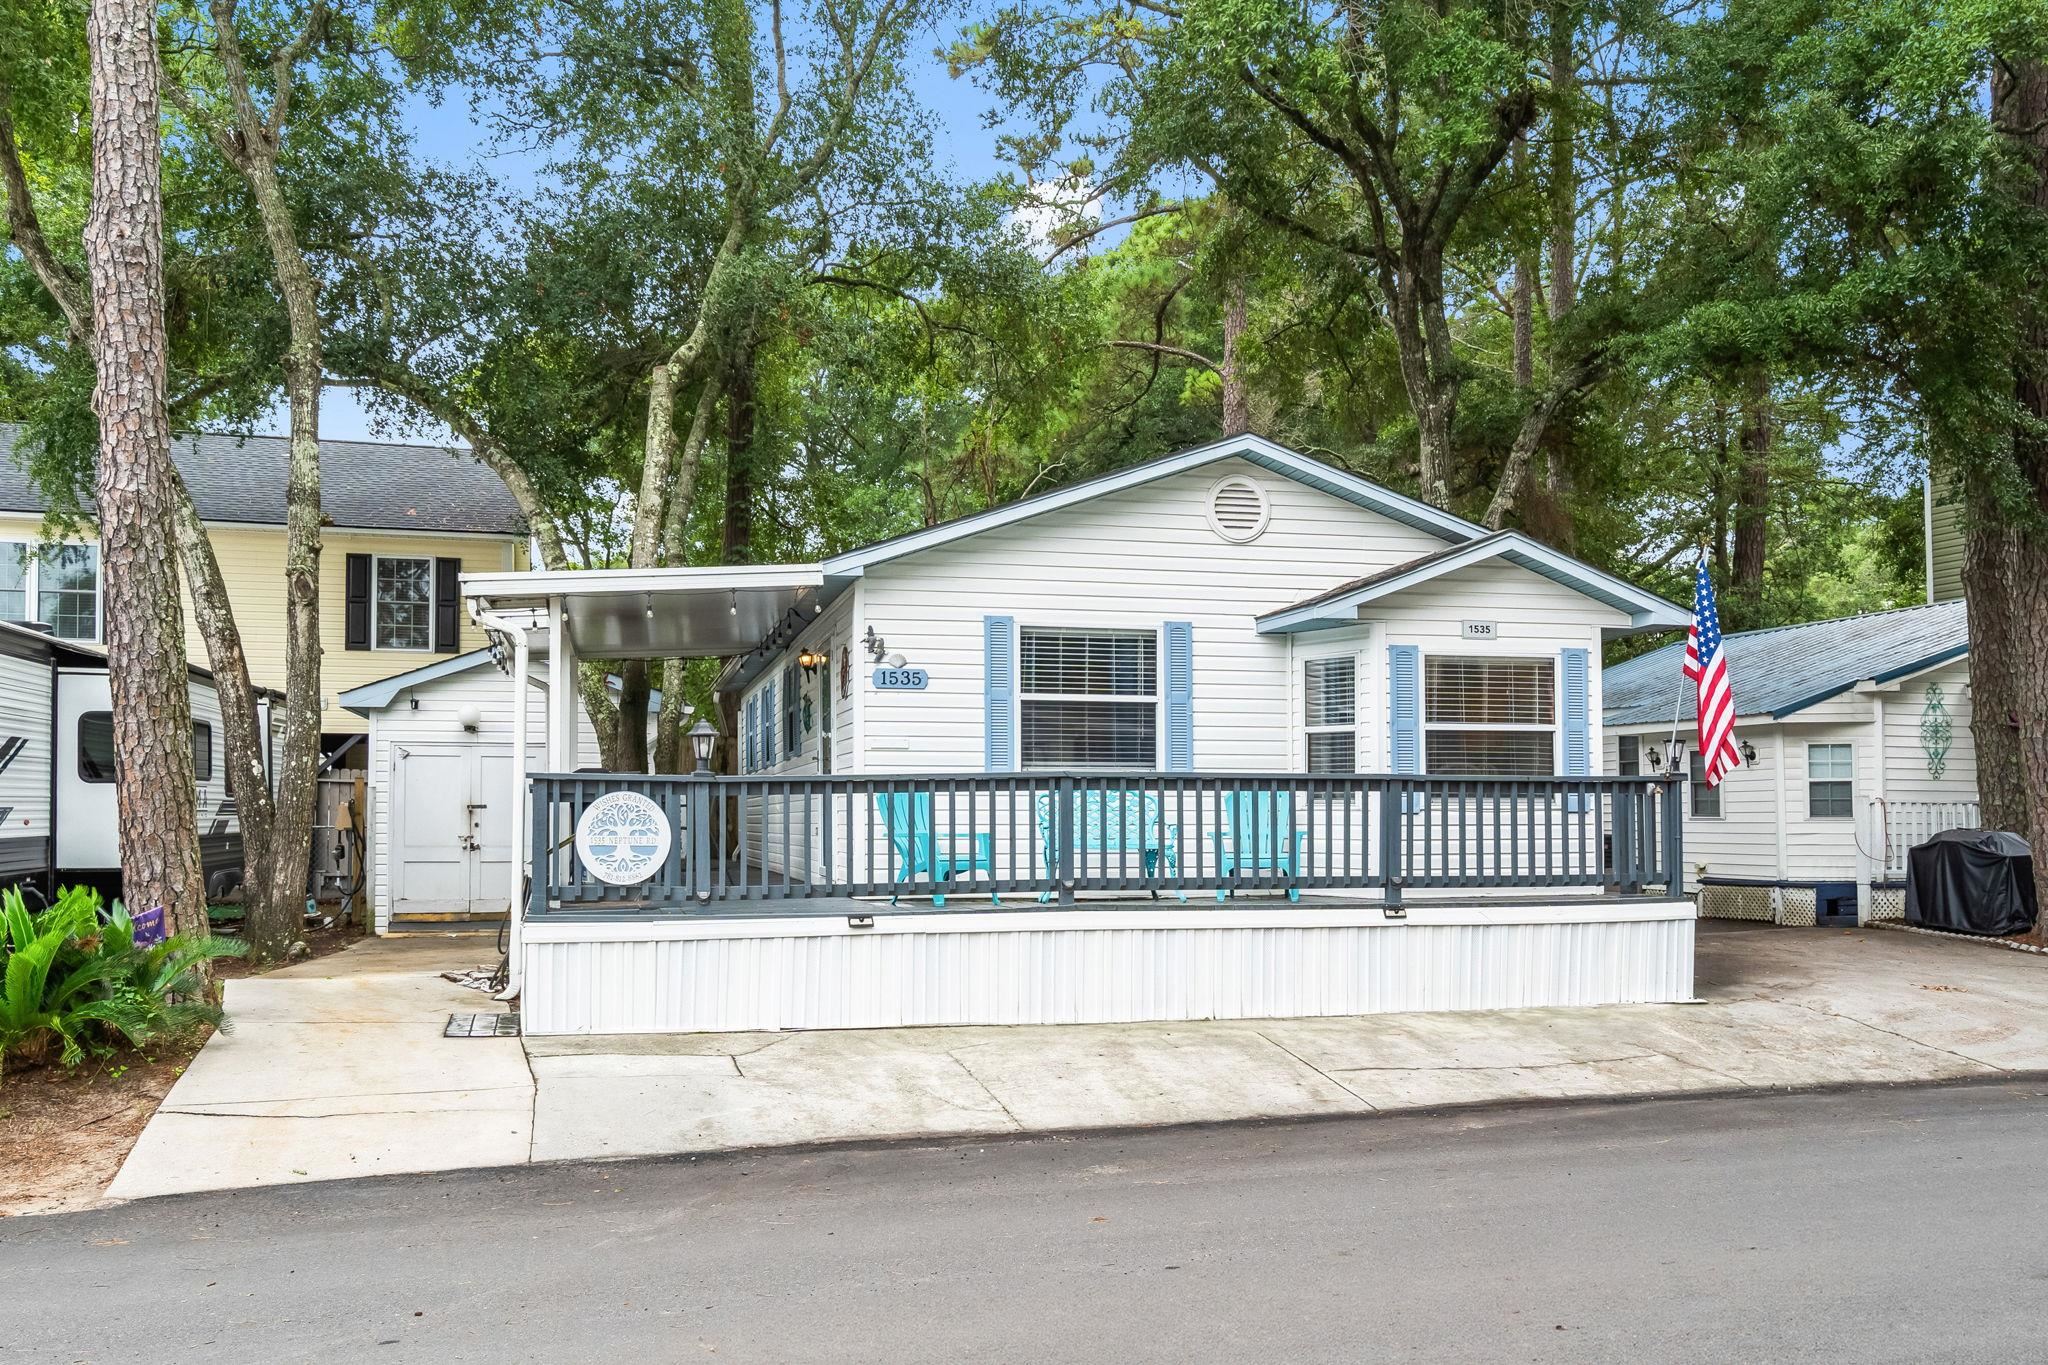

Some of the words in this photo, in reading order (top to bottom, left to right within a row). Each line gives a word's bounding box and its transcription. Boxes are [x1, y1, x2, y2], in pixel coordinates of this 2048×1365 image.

[1468, 624, 1491, 634] 1535
[880, 670, 922, 686] 1535
[593, 795, 620, 811] WISHES
[622, 793, 656, 812] GRANTED
[590, 836, 605, 844] 1535
[609, 836, 641, 844] NEPTUNE
[646, 836, 657, 844] RD
